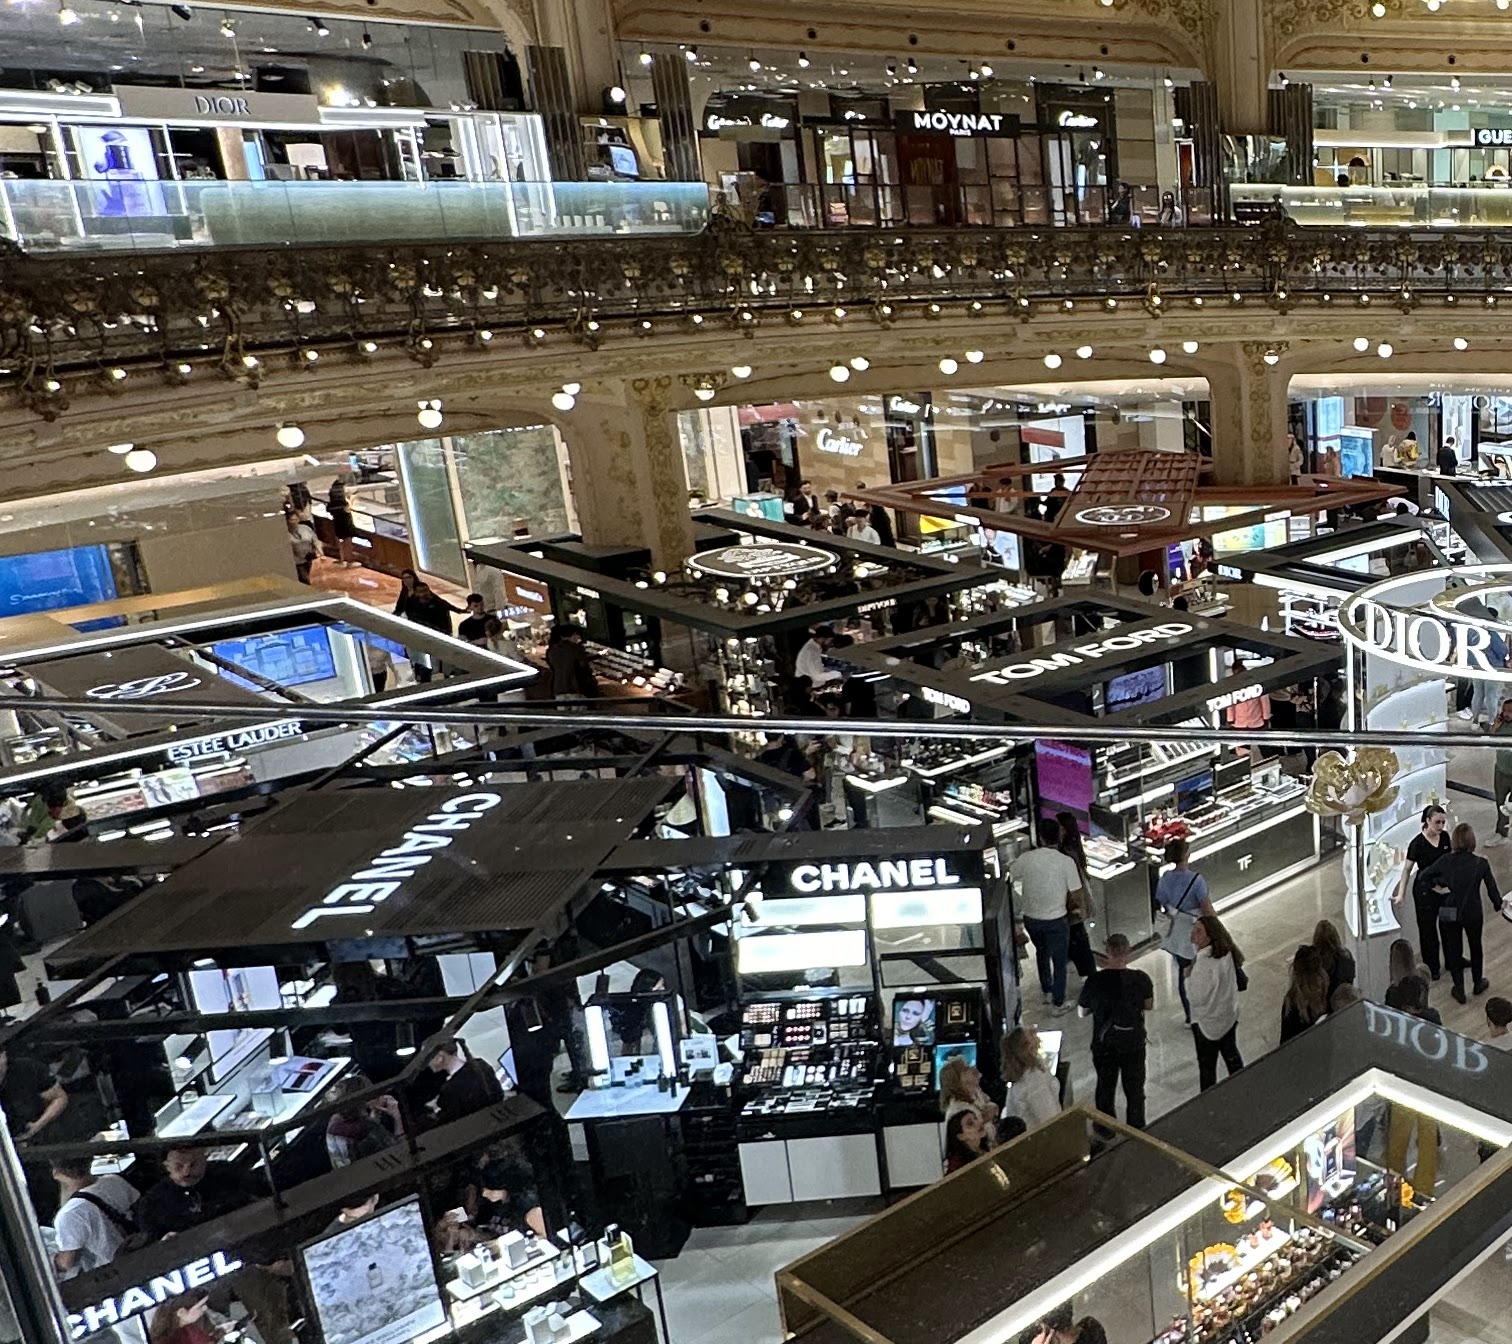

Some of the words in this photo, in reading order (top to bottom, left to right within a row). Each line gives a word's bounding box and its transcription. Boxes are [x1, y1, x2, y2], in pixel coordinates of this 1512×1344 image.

[194, 95, 251, 116] DIOR
[914, 112, 1003, 132] MOYNAT
[816, 427, 864, 457] Cartier
[1366, 602, 1499, 673] DIOR
[970, 653, 1084, 685] TOM
[1074, 623, 1193, 659] FORD
[921, 686, 945, 705] TOM
[944, 693, 971, 714] FORD
[1206, 693, 1232, 712] TOM
[1232, 684, 1263, 705] FORD
[227, 721, 303, 749] LAUDER
[291, 792, 502, 929] CHANEL
[1237, 854, 1252, 871] TF
[790, 858, 960, 893] CHANEL
[66, 1250, 243, 1339] CHANEL
